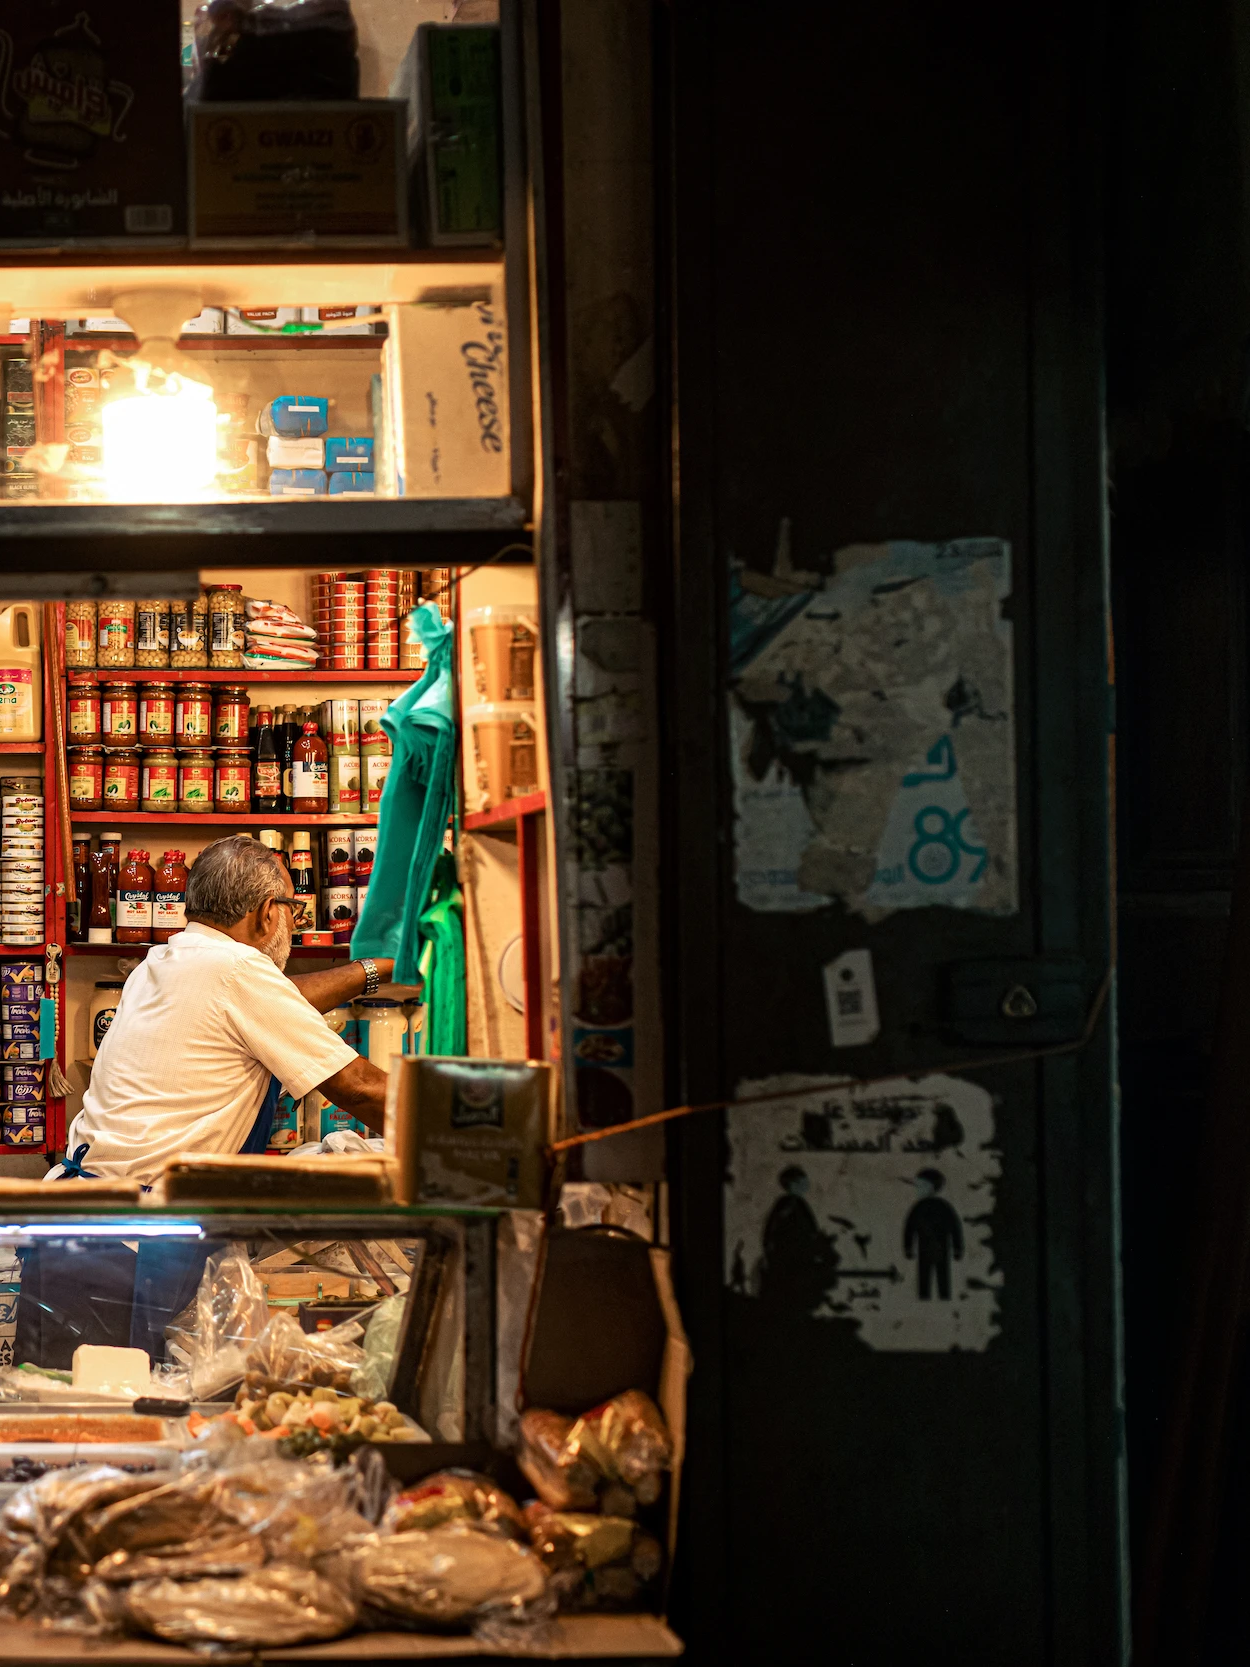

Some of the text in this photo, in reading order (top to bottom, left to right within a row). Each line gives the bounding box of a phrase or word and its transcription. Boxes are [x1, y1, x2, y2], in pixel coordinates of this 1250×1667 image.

[258, 128, 334, 149] GWAIZI
[459, 341, 504, 454] Cheese
[15, 796, 38, 804] Botan
[15, 817, 38, 825] Botan
[124, 891, 151, 902] Crystal
[155, 892, 181, 903] Crystal
[9, 1004, 28, 1015] Treva
[100, 1018, 113, 1026] Pu
[13, 1023, 31, 1035] Treva
[14, 1065, 32, 1076] Treva
